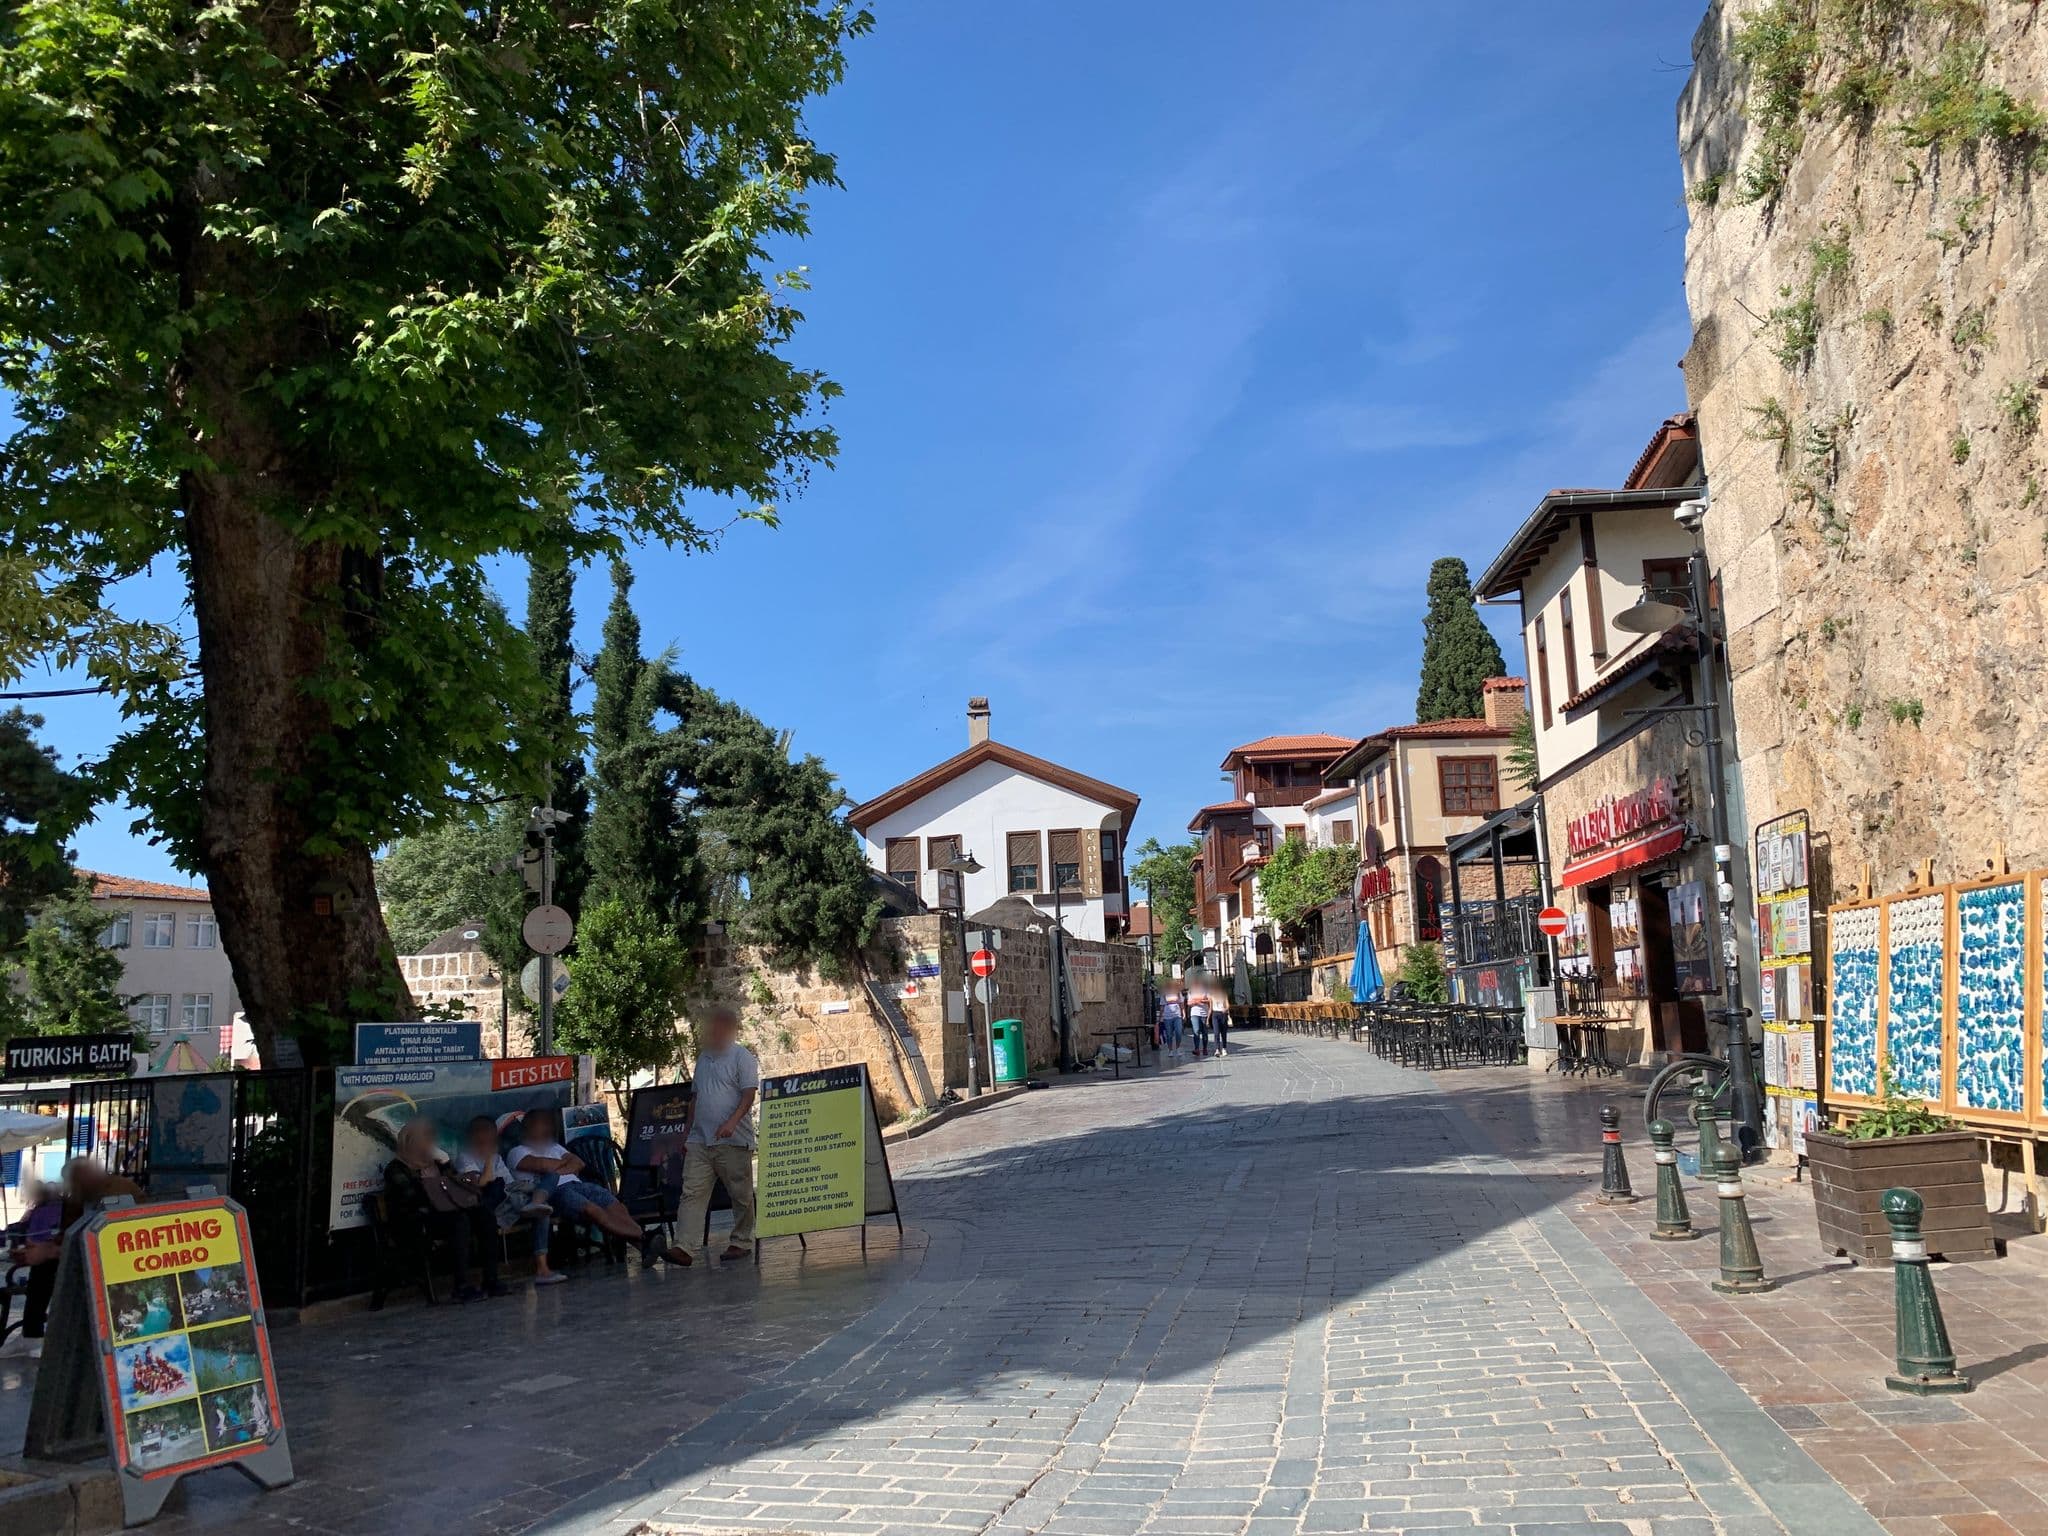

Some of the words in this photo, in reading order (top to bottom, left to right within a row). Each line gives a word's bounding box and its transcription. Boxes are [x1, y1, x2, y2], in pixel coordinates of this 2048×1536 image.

[384, 1027, 419, 1035] PLATANUS
[400, 1037, 422, 1045] ÇINAR
[423, 1036, 442, 1044] AĞACI
[374, 1047, 405, 1055] ANTALYA
[406, 1045, 432, 1054] KÜLTÜR
[10, 1046, 83, 1068] TURKISH
[89, 1043, 131, 1064] BATH
[343, 1074, 360, 1084] WITH
[362, 1074, 394, 1084] POWERED
[395, 1071, 434, 1082] PARAGLIDER
[500, 1066, 537, 1088] LET'S
[541, 1062, 566, 1080] FLY
[830, 1077, 859, 1086] TRAVEL
[784, 1100, 810, 1108] TICKETS
[784, 1108, 812, 1117] TICKETS
[794, 1118, 808, 1126] CAR
[814, 1133, 843, 1142] AIRPORT
[829, 1141, 856, 1150] STATION
[786, 1157, 810, 1166] CRUISE
[790, 1166, 821, 1175] BOOKING
[811, 1184, 828, 1192] TOUR
[800, 1196, 820, 1204] FLAME
[823, 1192, 848, 1200] STONES
[804, 1204, 832, 1213] DOLPHIN
[834, 1201, 854, 1209] SHOW
[133, 1246, 209, 1272] COMBO
